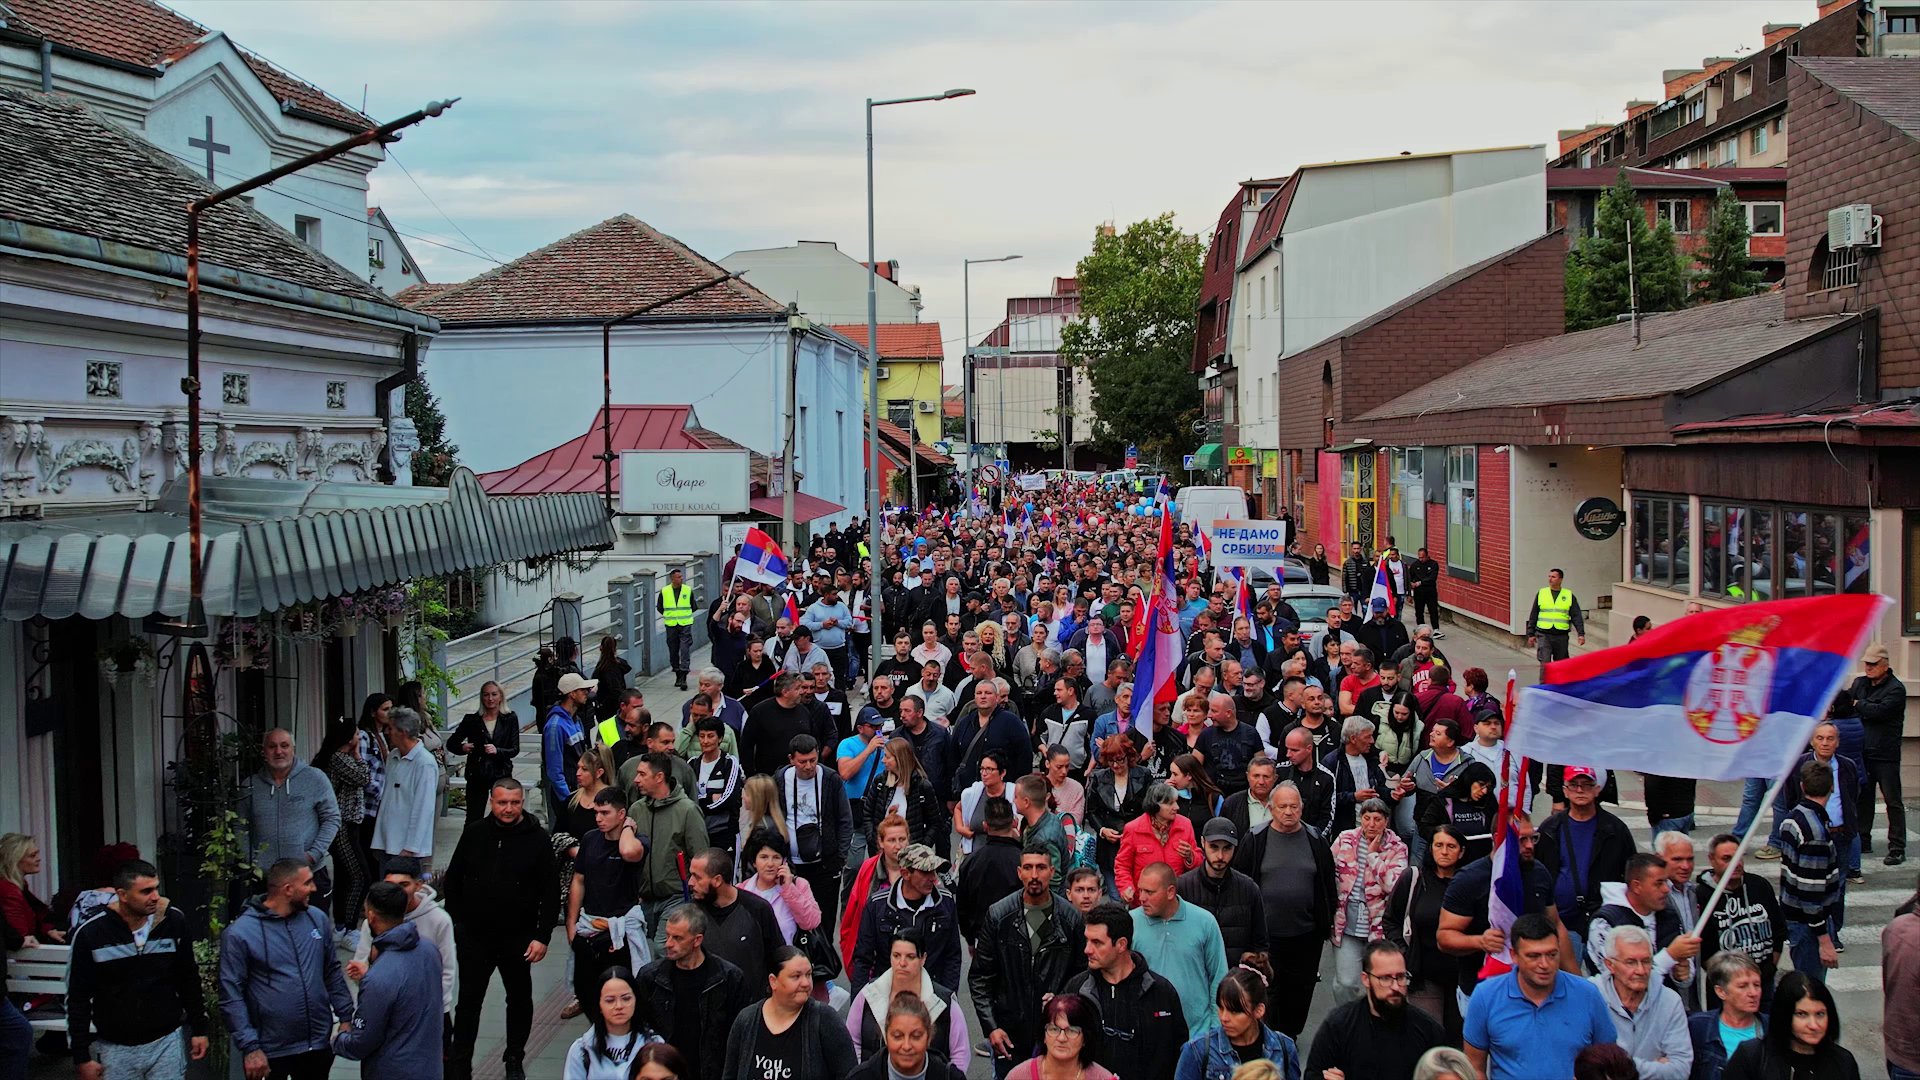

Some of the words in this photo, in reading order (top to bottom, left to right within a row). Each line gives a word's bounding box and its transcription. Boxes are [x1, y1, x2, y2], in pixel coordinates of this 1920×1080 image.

[656, 467, 706, 491] Agape
[652, 503, 678, 511] TORTE
[1219, 528, 1236, 539] НЕ
[1239, 528, 1279, 541] ДАМО
[1222, 543, 1276, 554] СРБИЈУ!
[1412, 669, 1430, 686] HARV
[755, 1054, 783, 1070] You
